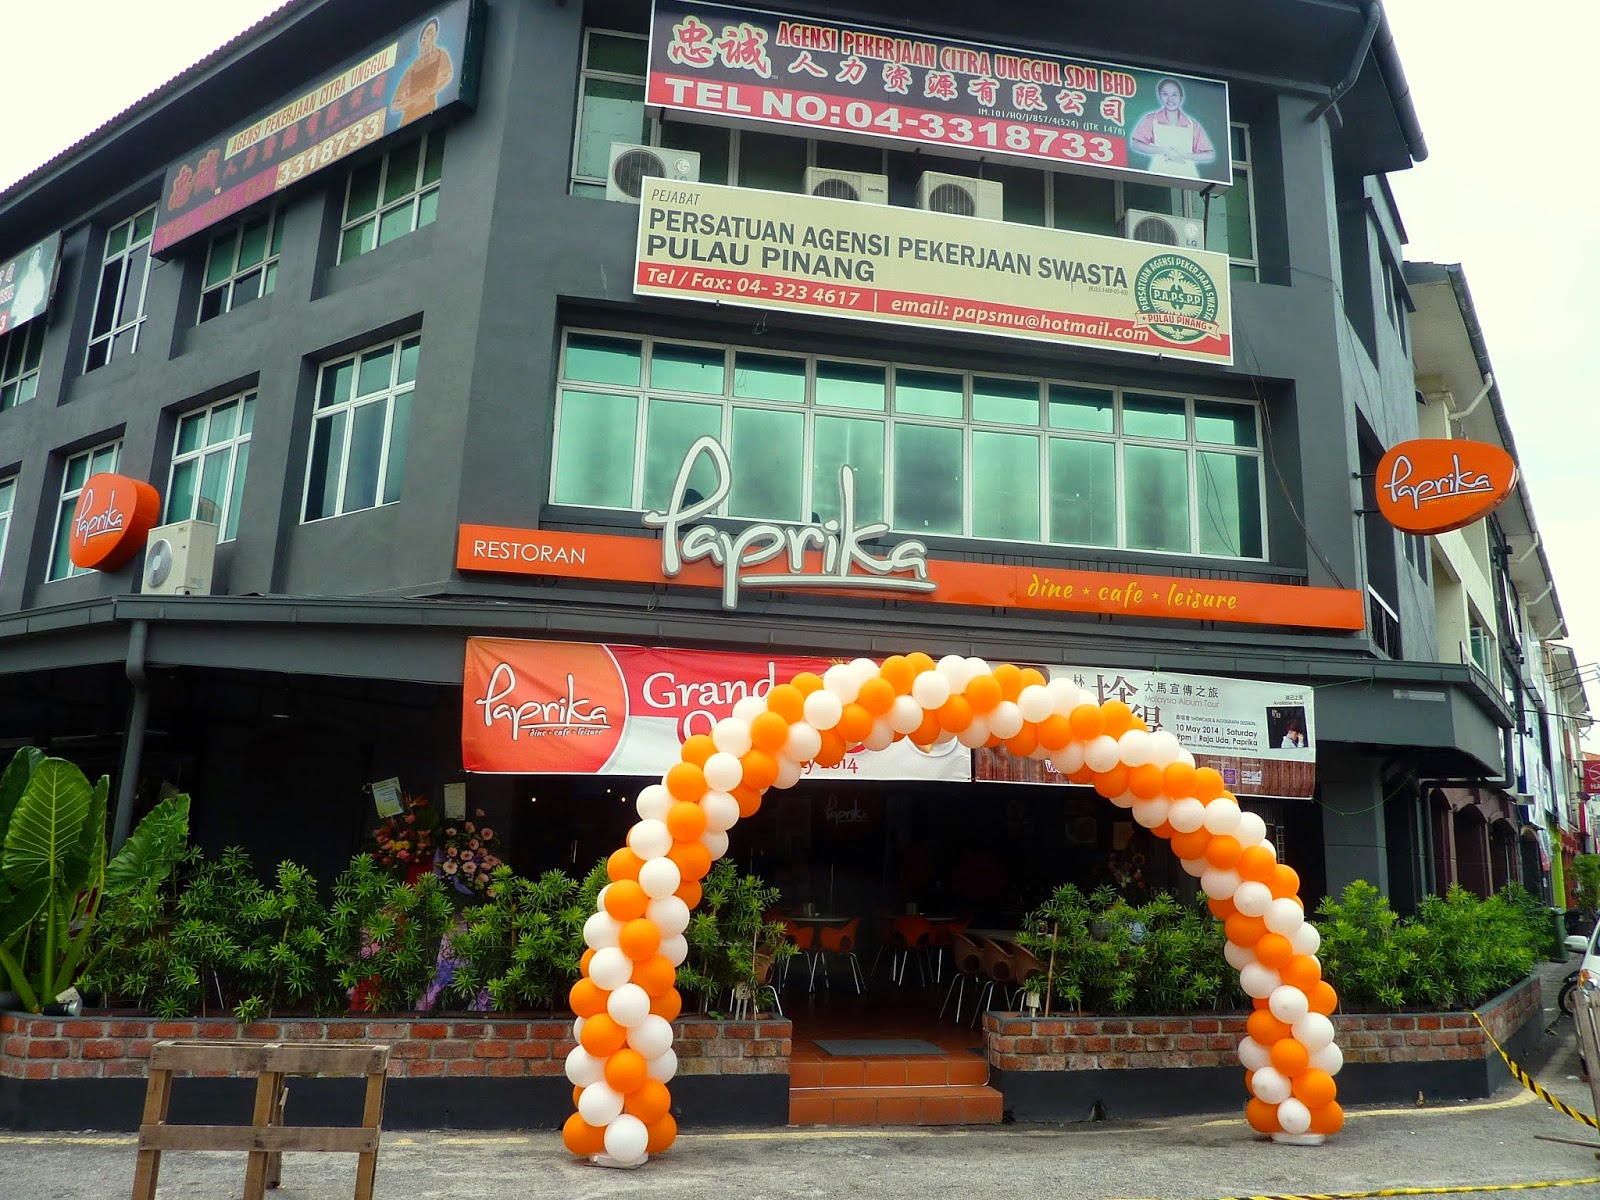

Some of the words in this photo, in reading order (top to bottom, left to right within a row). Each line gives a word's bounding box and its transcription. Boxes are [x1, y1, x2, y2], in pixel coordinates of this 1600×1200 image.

[777, 21, 838, 52] AGENSI
[842, 31, 937, 69] PEKERJAAN
[940, 46, 991, 76] CITRA
[995, 55, 1063, 86] UNGGUL
[1064, 65, 1100, 91] SDN
[1100, 71, 1137, 97] BHD
[230, 123, 263, 154] AGENSI
[264, 93, 317, 136] PEKERJAAN
[319, 75, 347, 106] CITRA
[350, 51, 389, 87] UNGGUL
[664, 77, 751, 113] TEL
[788, 51, 1126, 126] 人力资源有限公司
[277, 114, 380, 185] 3318733
[651, 188, 701, 206] PEJABAT
[647, 234, 750, 266] PULAU
[761, 246, 875, 282] PINANG
[649, 207, 795, 245] PERSATUAN
[801, 226, 890, 257] AGENSI
[898, 236, 1031, 276] PEKERJAAN
[1037, 256, 1128, 289] SWASTA
[1186, 238, 1198, 247] LG
[647, 267, 674, 285] Tel
[691, 272, 732, 291] Fax:
[737, 277, 768, 295] 04-
[774, 281, 808, 301] 323
[812, 287, 861, 306] 4617
[891, 298, 949, 317] email:
[952, 304, 1150, 342] papsmu@hotmail.com
[1138, 267, 1152, 311] PERSATUAN
[1149, 257, 1175, 271] AGENSI
[1176, 257, 1212, 291] PEKERJAAN
[1203, 291, 1215, 321] SWASTA
[1148, 313, 1174, 324] PULAU
[1176, 315, 1207, 330] PINANG
[1383, 453, 1491, 510] Paprika
[75, 488, 124, 546] Paprika
[641, 435, 935, 611] Paprika
[473, 539, 586, 566] RESTORAN
[1027, 574, 1073, 599] dine
[1098, 581, 1144, 608] cafe
[1167, 584, 1237, 610] leisure
[475, 663, 608, 740] Paprika
[642, 661, 776, 709] Grand
[1144, 681, 1219, 699] 大馬宣傳之旅
[1145, 695, 1177, 705] Malaysia
[1178, 697, 1203, 707] Album
[1204, 699, 1220, 708] Tour
[529, 728, 547, 737] dine
[553, 727, 570, 738] cafe
[577, 727, 603, 736] leisure
[1176, 724, 1184, 732] 10
[1186, 725, 1201, 734] May
[1203, 726, 1219, 734] 2014
[1227, 728, 1258, 739] Saturday
[1176, 733, 1192, 741] 9pm
[1232, 738, 1258, 747] Paprika
